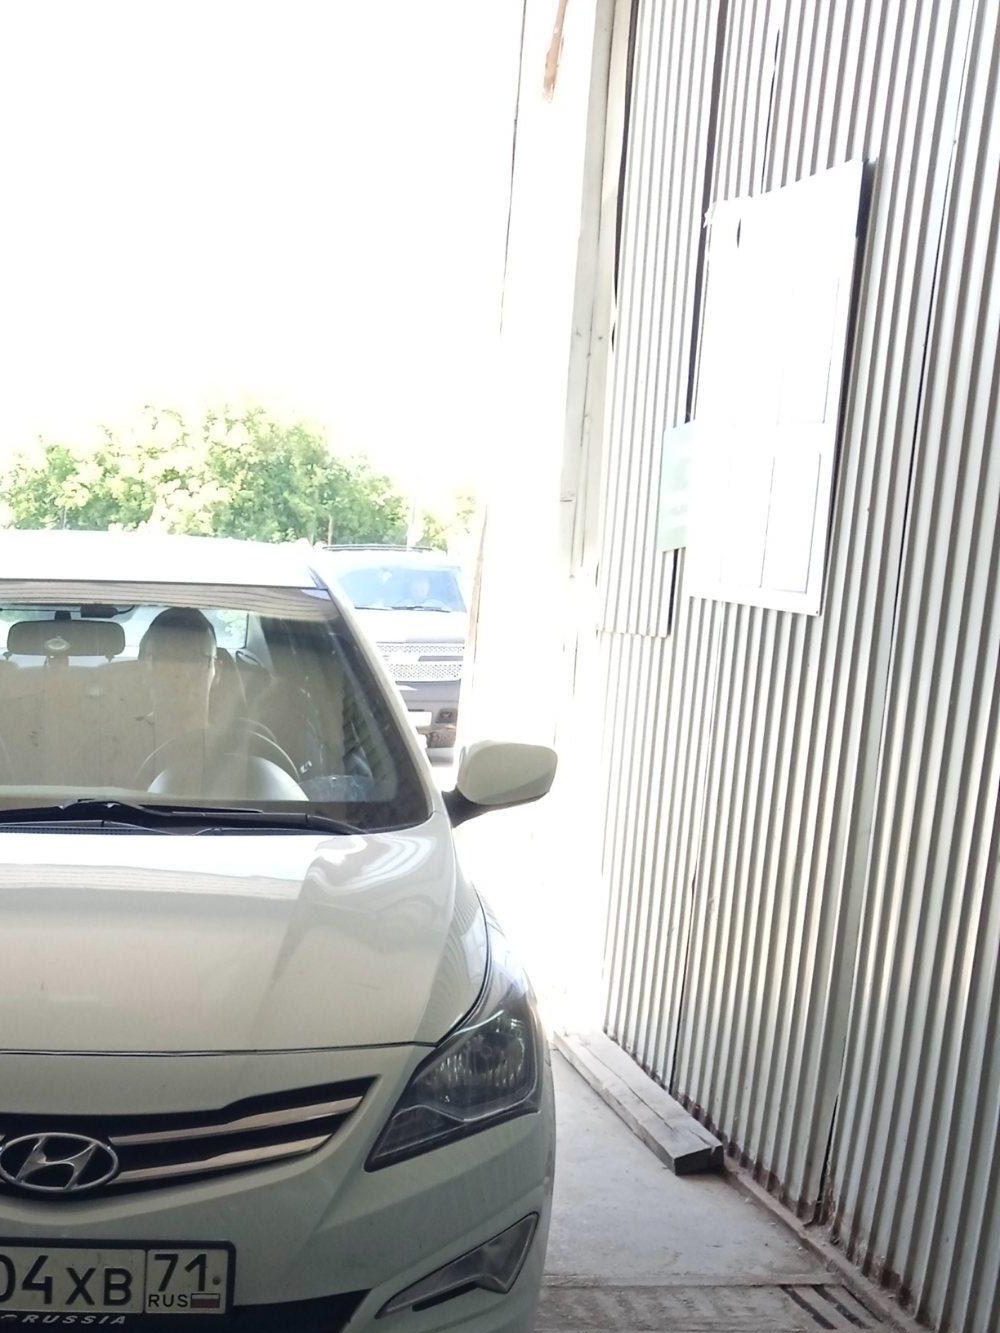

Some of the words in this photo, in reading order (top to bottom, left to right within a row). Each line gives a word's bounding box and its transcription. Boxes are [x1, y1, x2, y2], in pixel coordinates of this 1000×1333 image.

[153, 1253, 207, 1293] 71
[147, 1293, 189, 1309] RUS
[21, 1313, 127, 1326] RUSSIA
